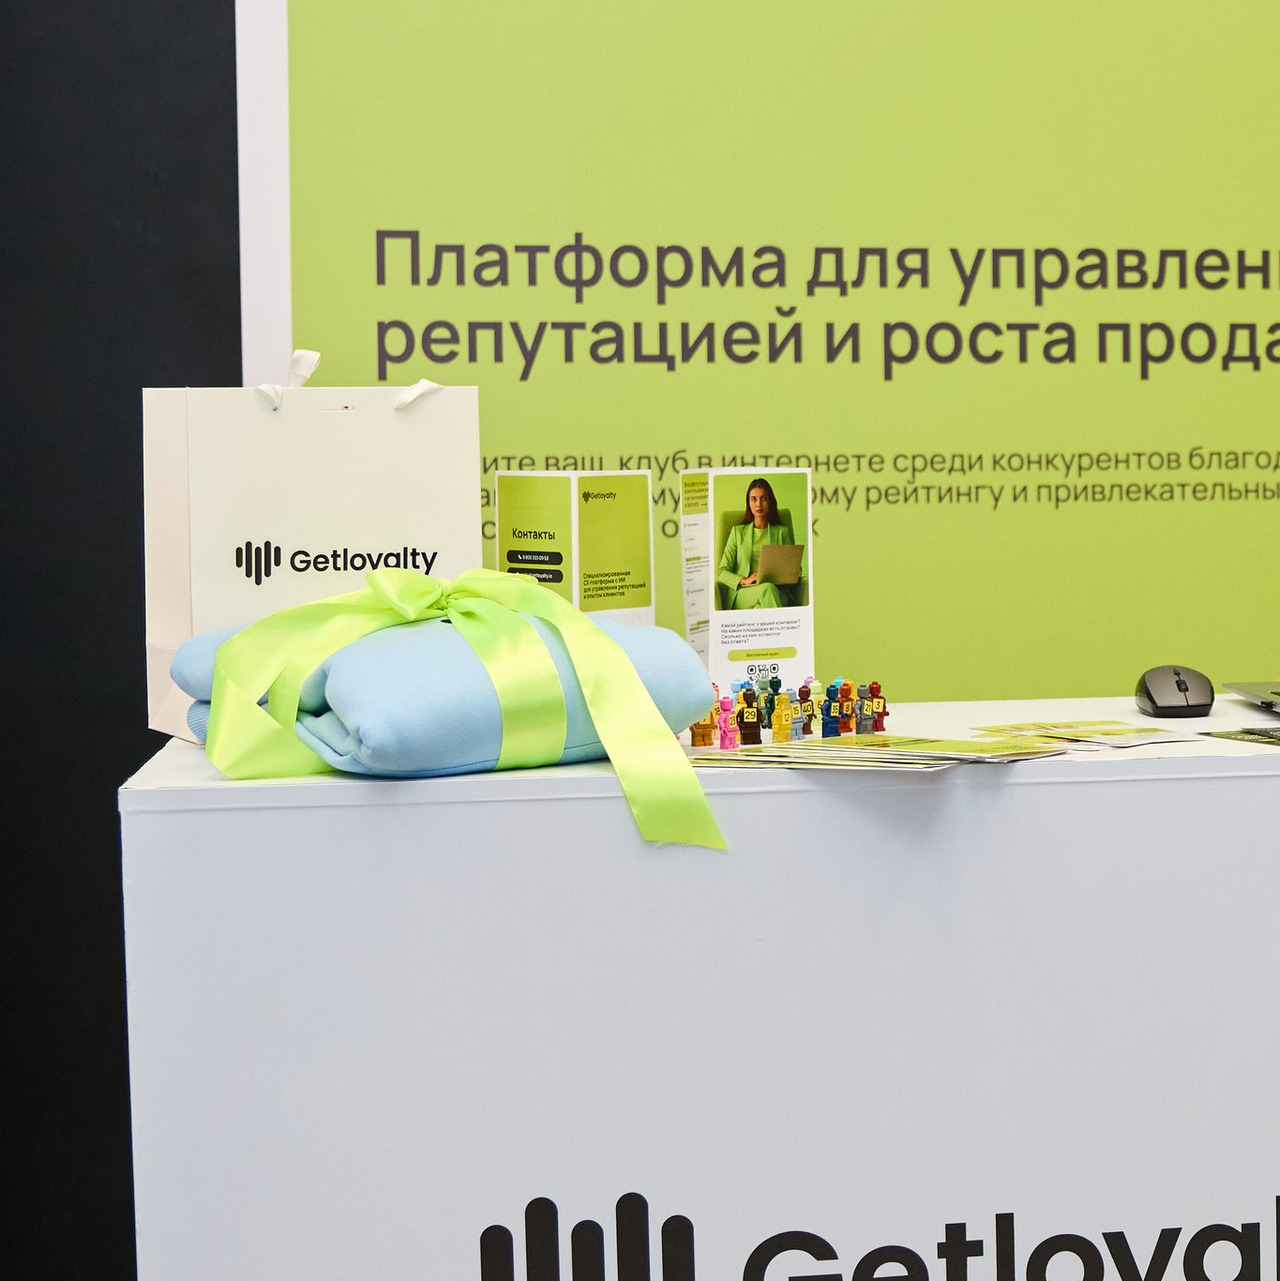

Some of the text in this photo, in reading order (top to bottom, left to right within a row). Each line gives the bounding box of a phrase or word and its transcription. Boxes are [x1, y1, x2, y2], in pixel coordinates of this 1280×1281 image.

[375, 229, 787, 305] Платформа
[806, 247, 930, 297] для
[376, 306, 802, 381] репутацией
[825, 322, 860, 363] и
[883, 322, 1077, 381] роста
[619, 450, 688, 481] клуб
[721, 452, 890, 473] интернете
[893, 451, 984, 479] среди
[992, 450, 1181, 477] конкурентов
[866, 479, 1004, 510] рейтингу
[1012, 483, 1028, 502] и
[511, 528, 556, 540] Контакты
[802, 701, 811, 713] 40
[875, 700, 881, 710] 3
[744, 710, 756, 720] 29
[783, 713, 790, 722] 12
